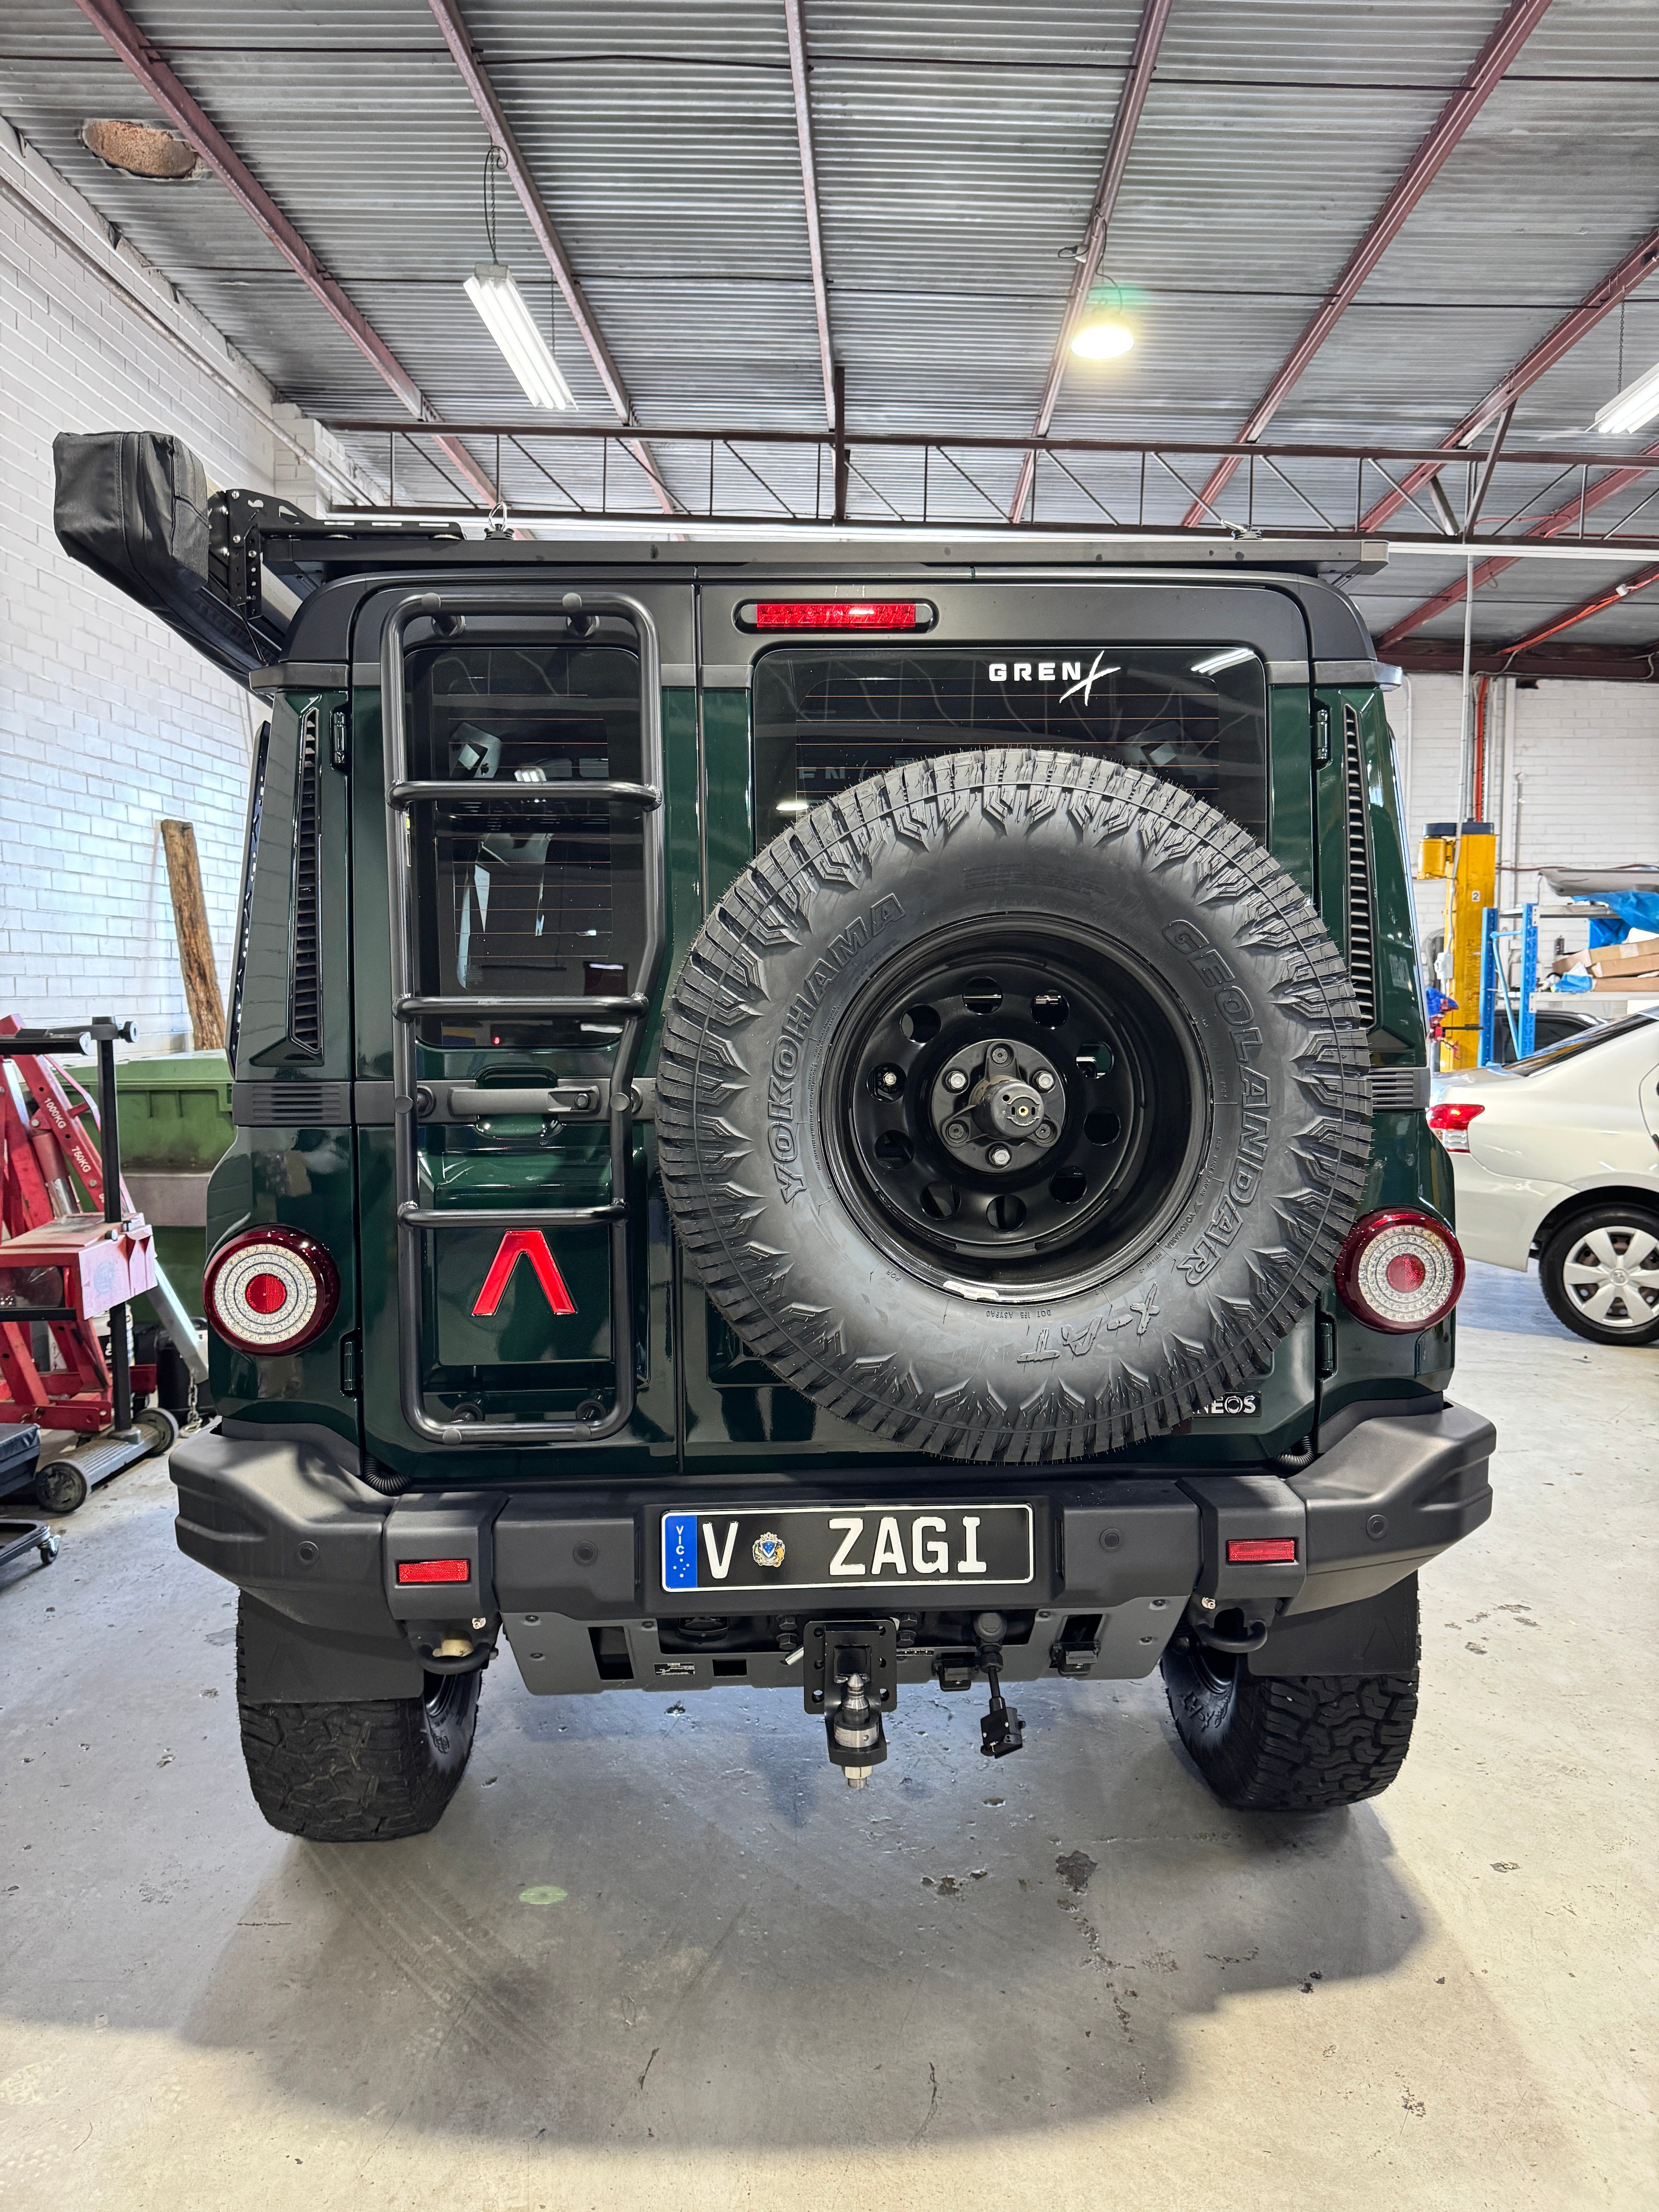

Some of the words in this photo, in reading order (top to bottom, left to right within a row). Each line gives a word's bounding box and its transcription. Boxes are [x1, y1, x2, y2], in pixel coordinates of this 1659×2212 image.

[1473, 892, 1479, 900] 2
[768, 893, 906, 1203] YOKOHAMA
[44, 1098, 67, 1129] 1000KG
[1162, 920, 1271, 1285] GEOLANDAR
[71, 1146, 91, 1173] 750KG
[1165, 1212, 1196, 1249] YOKOHAMA
[1017, 1282, 1160, 1362] X-AT
[1037, 1308, 1051, 1317] DOT
[676, 1525, 684, 1555] VIC
[702, 1521, 739, 1579] V
[829, 1516, 987, 1576] ZAGI
